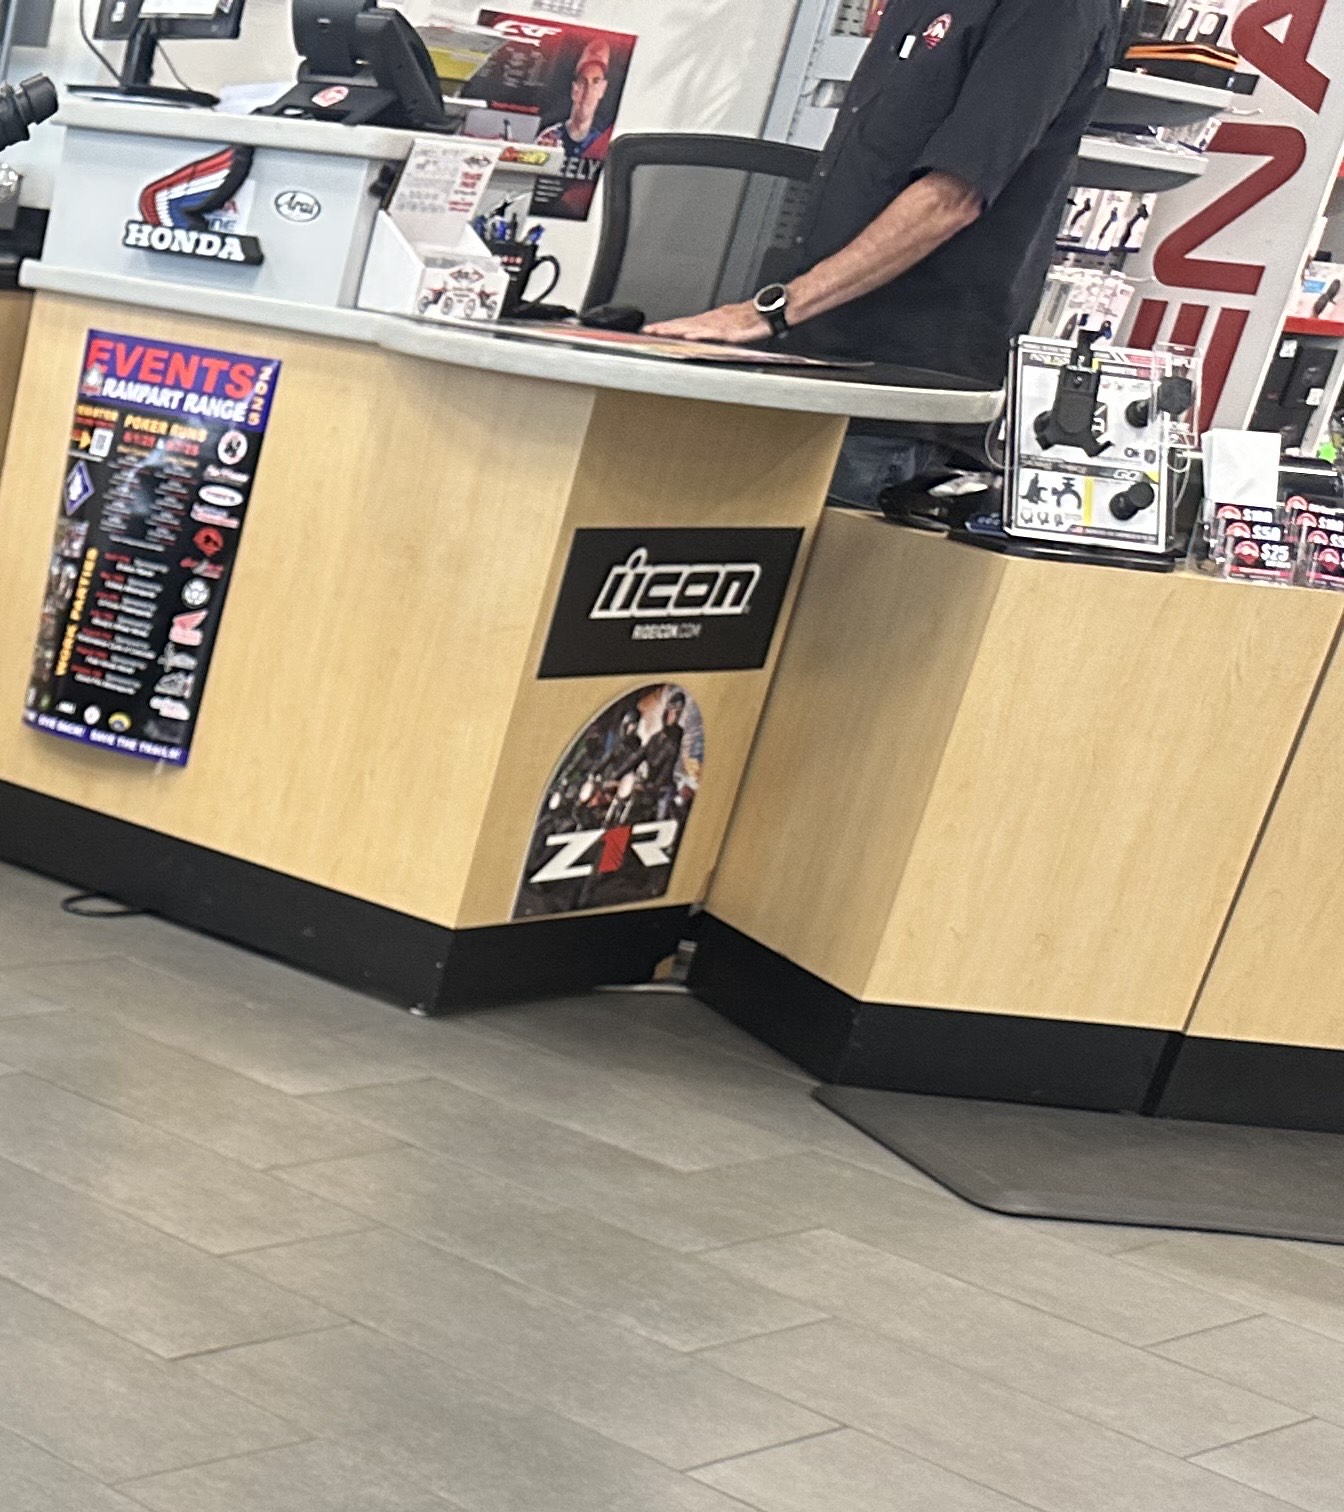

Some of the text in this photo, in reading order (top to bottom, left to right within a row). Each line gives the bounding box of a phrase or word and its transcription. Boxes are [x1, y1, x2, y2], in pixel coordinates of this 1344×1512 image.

[125, 222, 245, 262] HONDA
[86, 337, 257, 401] EVENTS
[102, 376, 248, 424] RAMPART RANGE
[1261, 543, 1290, 562] $25
